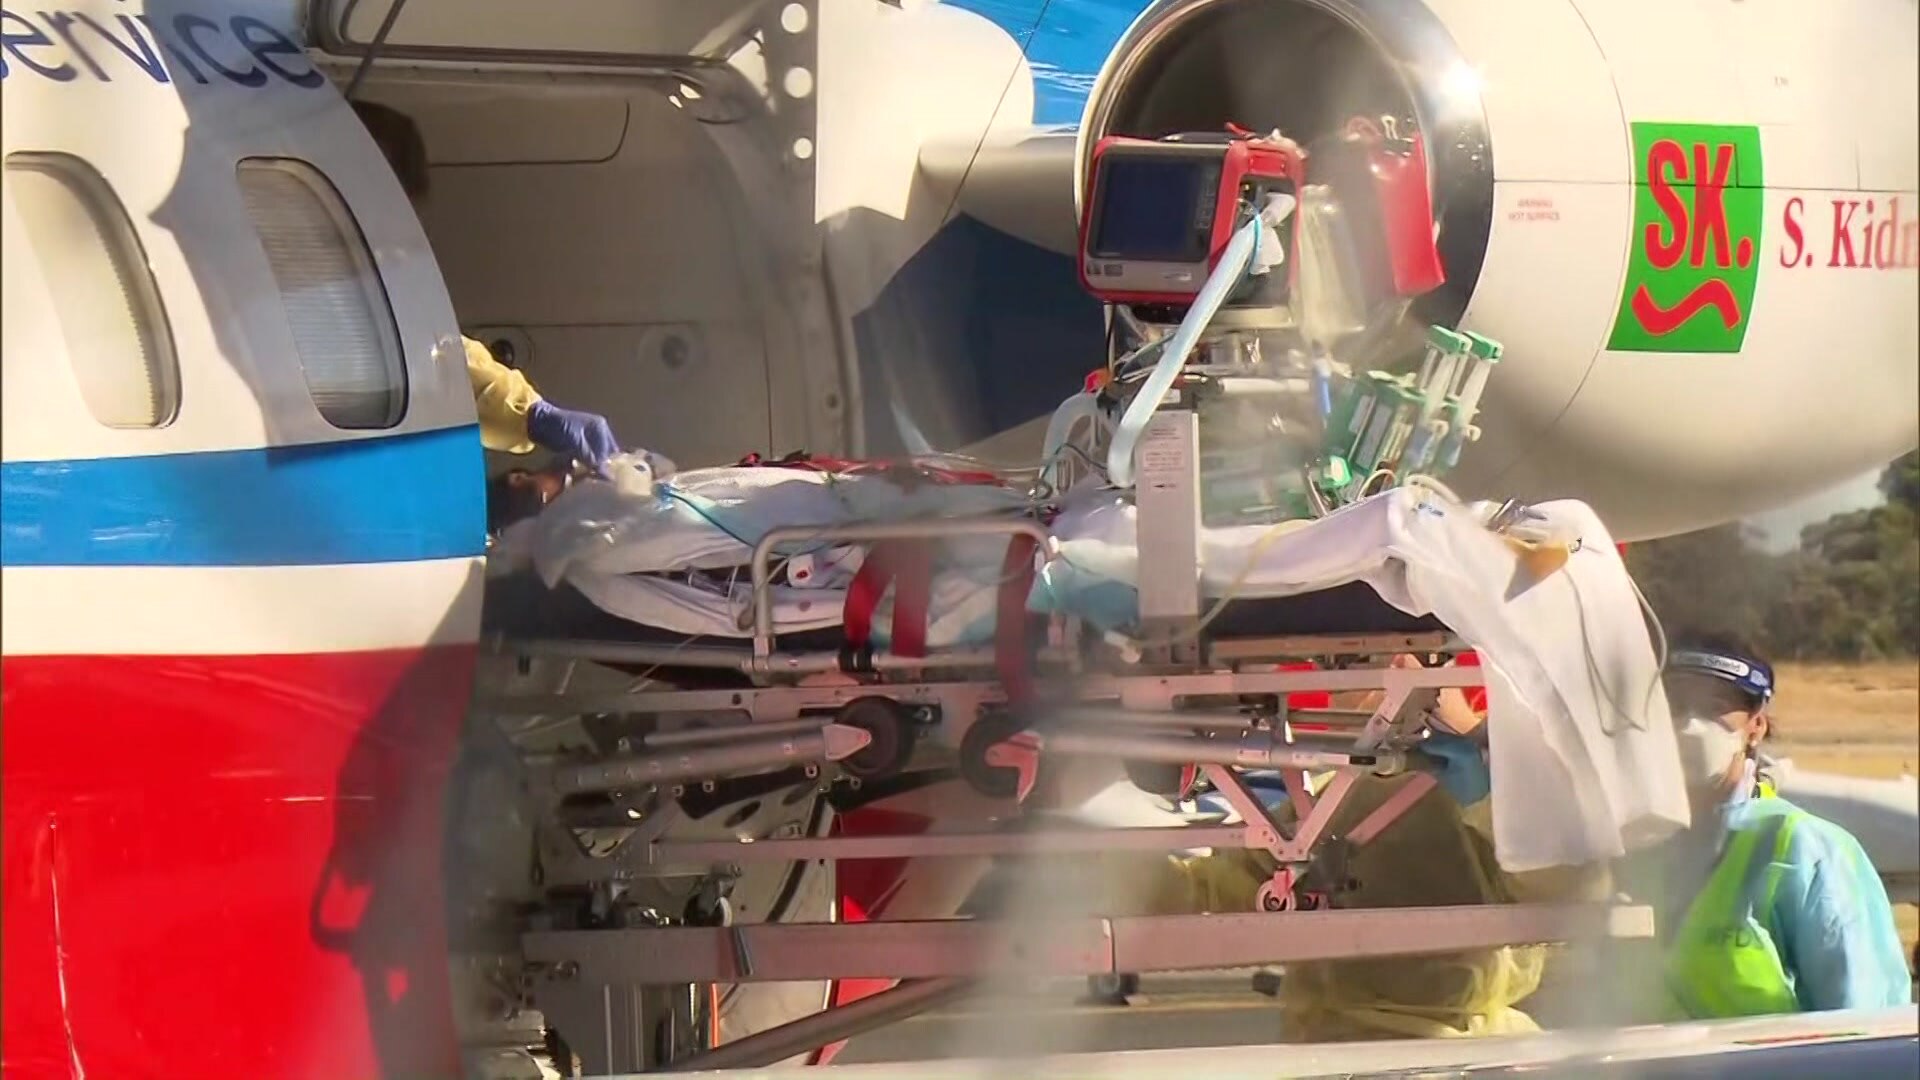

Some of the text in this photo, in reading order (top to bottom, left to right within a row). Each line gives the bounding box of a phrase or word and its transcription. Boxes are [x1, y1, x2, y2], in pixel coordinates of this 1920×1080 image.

[1, 0, 325, 88] ervice
[1645, 139, 1753, 269] SK.
[1780, 197, 1813, 269] S.
